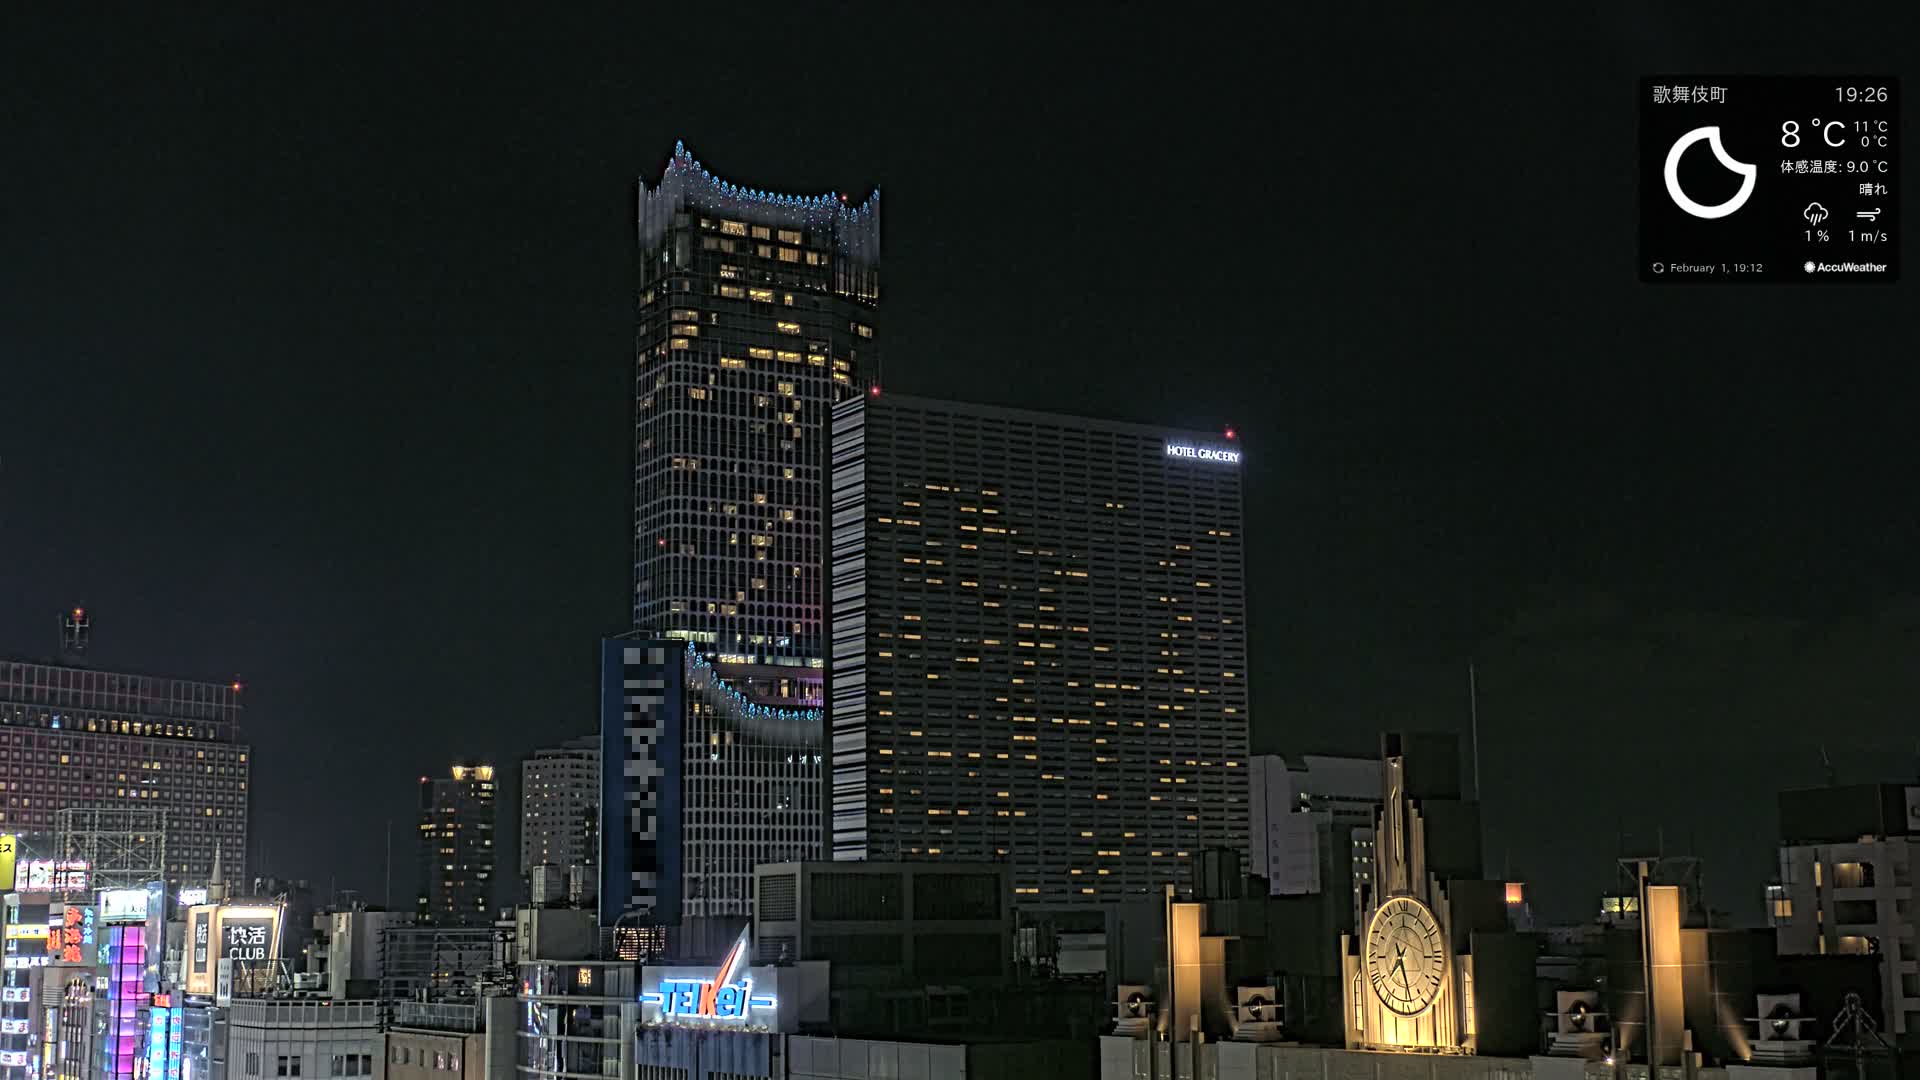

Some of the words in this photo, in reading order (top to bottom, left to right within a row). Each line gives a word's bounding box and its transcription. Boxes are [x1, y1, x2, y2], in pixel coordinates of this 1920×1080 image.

[1167, 445, 1197, 458] HOTEL
[1198, 449, 1240, 462] GRACERY
[0, 843, 12, 853] ス
[229, 926, 266, 945] 快活
[229, 947, 265, 960] CLUB
